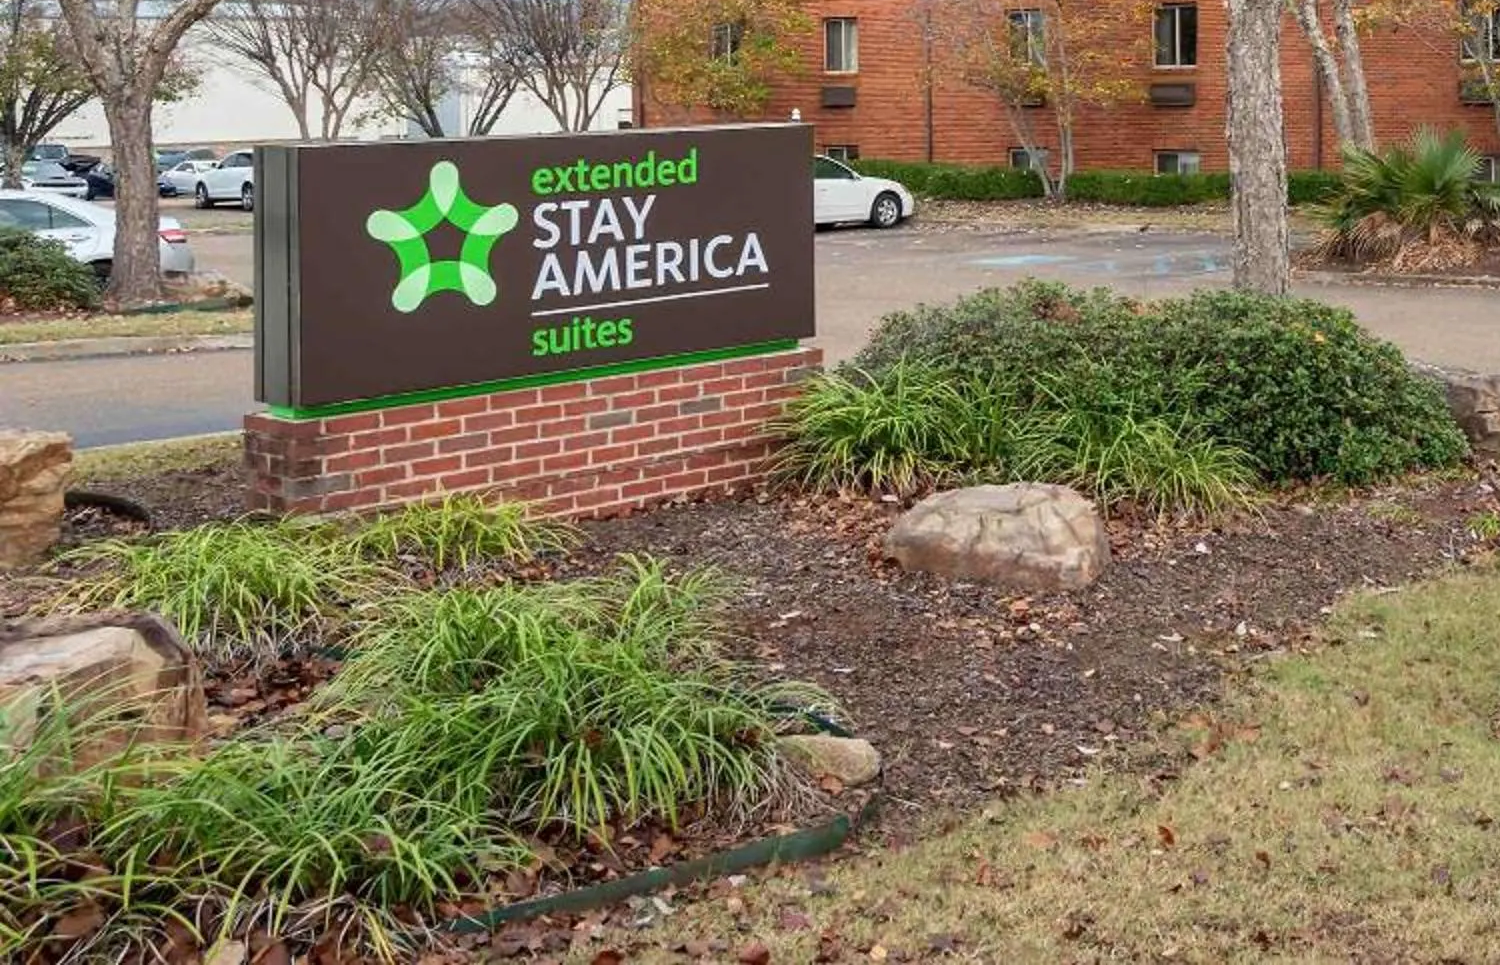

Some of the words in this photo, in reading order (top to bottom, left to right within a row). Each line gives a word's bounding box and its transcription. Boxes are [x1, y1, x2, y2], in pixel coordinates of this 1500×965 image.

[532, 148, 698, 194] extended
[532, 195, 657, 249] STAY
[531, 232, 769, 300] AMERICA
[532, 317, 634, 356] suites
